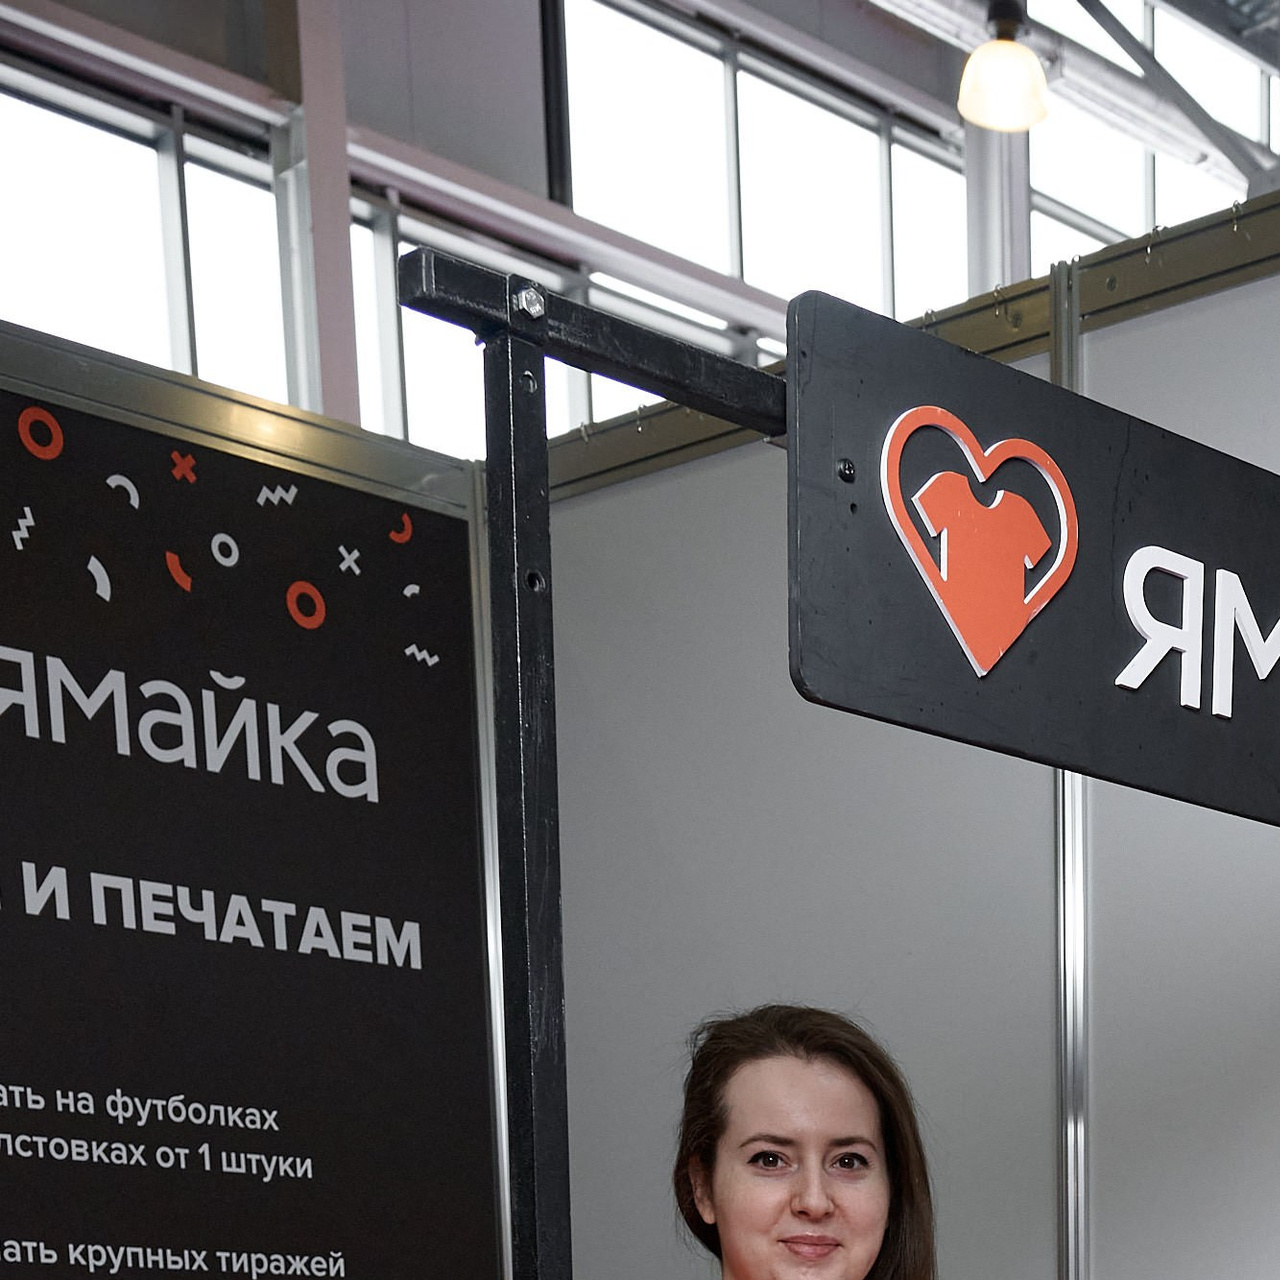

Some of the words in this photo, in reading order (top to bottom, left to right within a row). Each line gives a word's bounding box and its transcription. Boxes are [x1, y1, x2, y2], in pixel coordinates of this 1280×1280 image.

[22, 861, 70, 920] И
[90, 872, 422, 970] ПЕЧАТАЕМ
[56, 1090, 95, 1115] на
[105, 1088, 280, 1131] футболках
[156, 1147, 190, 1169] от
[198, 1143, 211, 1170] 1
[222, 1151, 313, 1183] штуки
[0, 1240, 58, 1264] ать
[68, 1243, 209, 1275] крупных
[216, 1250, 346, 1280] тиражей
